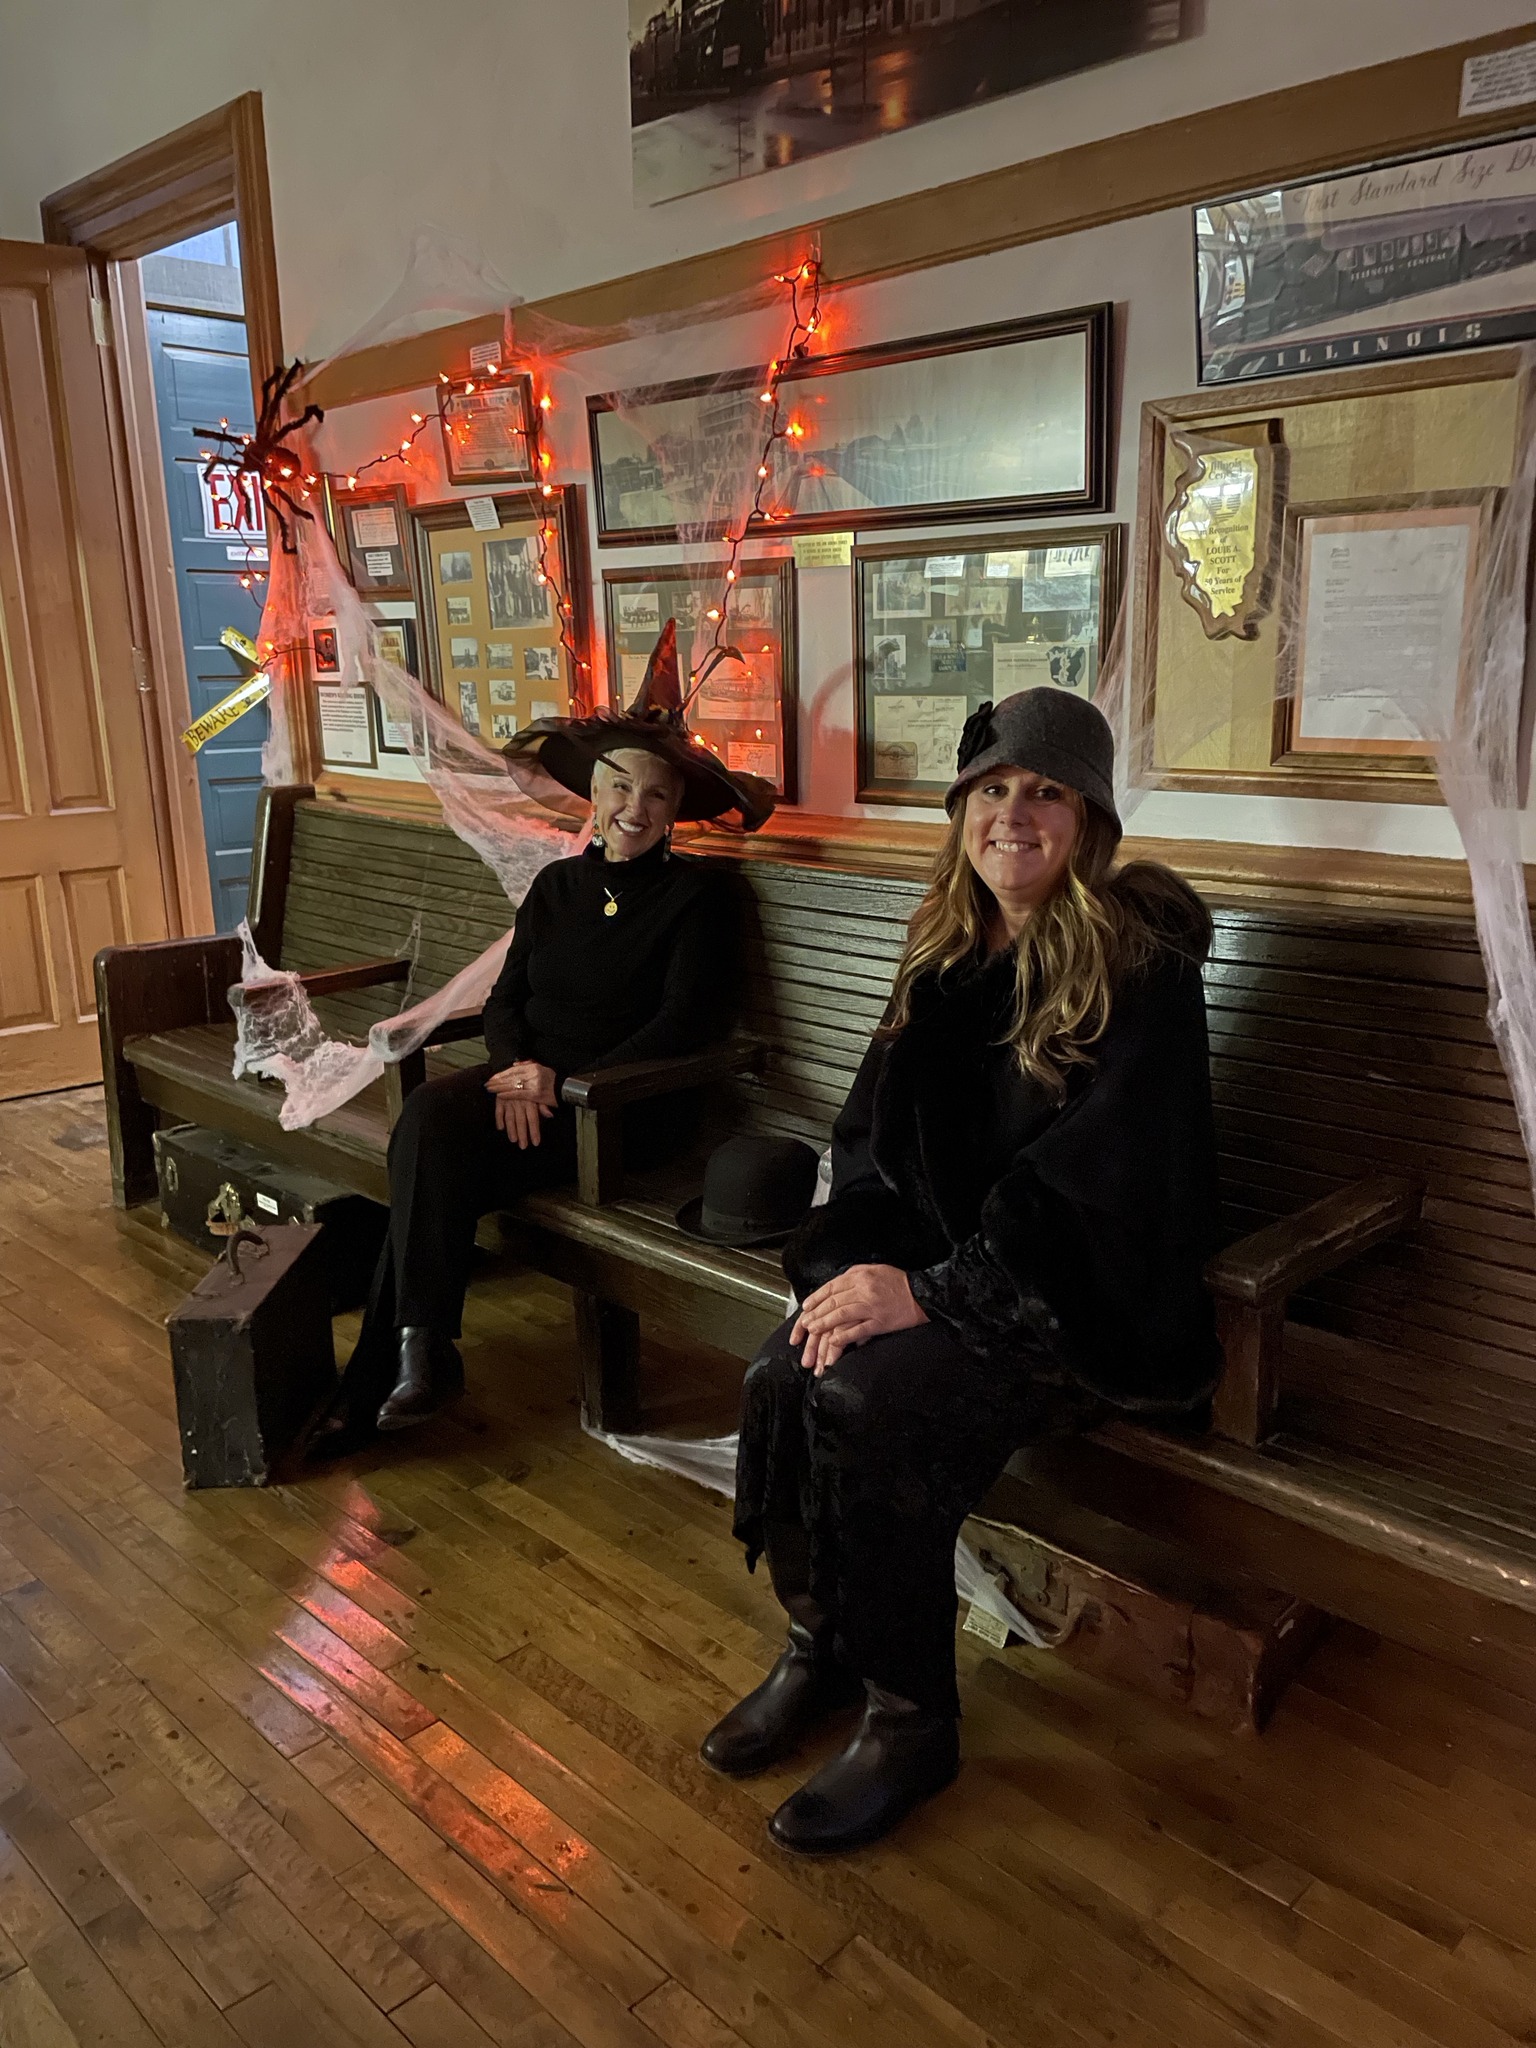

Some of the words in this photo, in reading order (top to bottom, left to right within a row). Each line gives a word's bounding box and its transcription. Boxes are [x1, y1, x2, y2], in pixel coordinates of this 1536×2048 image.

[1350, 162, 1443, 206] Standard
[1452, 154, 1496, 189] Size
[1276, 322, 1482, 367] ILLINOIS
[208, 473, 264, 531] EXI
[1208, 524, 1249, 535] Recognition
[1220, 535, 1227, 544] of
[1206, 546, 1231, 555] LOUIE
[1209, 555, 1237, 565] SCOTT
[1217, 567, 1229, 575] For
[1214, 577, 1233, 585] Years
[1211, 587, 1236, 595] Service
[185, 705, 240, 748] BEWARE
